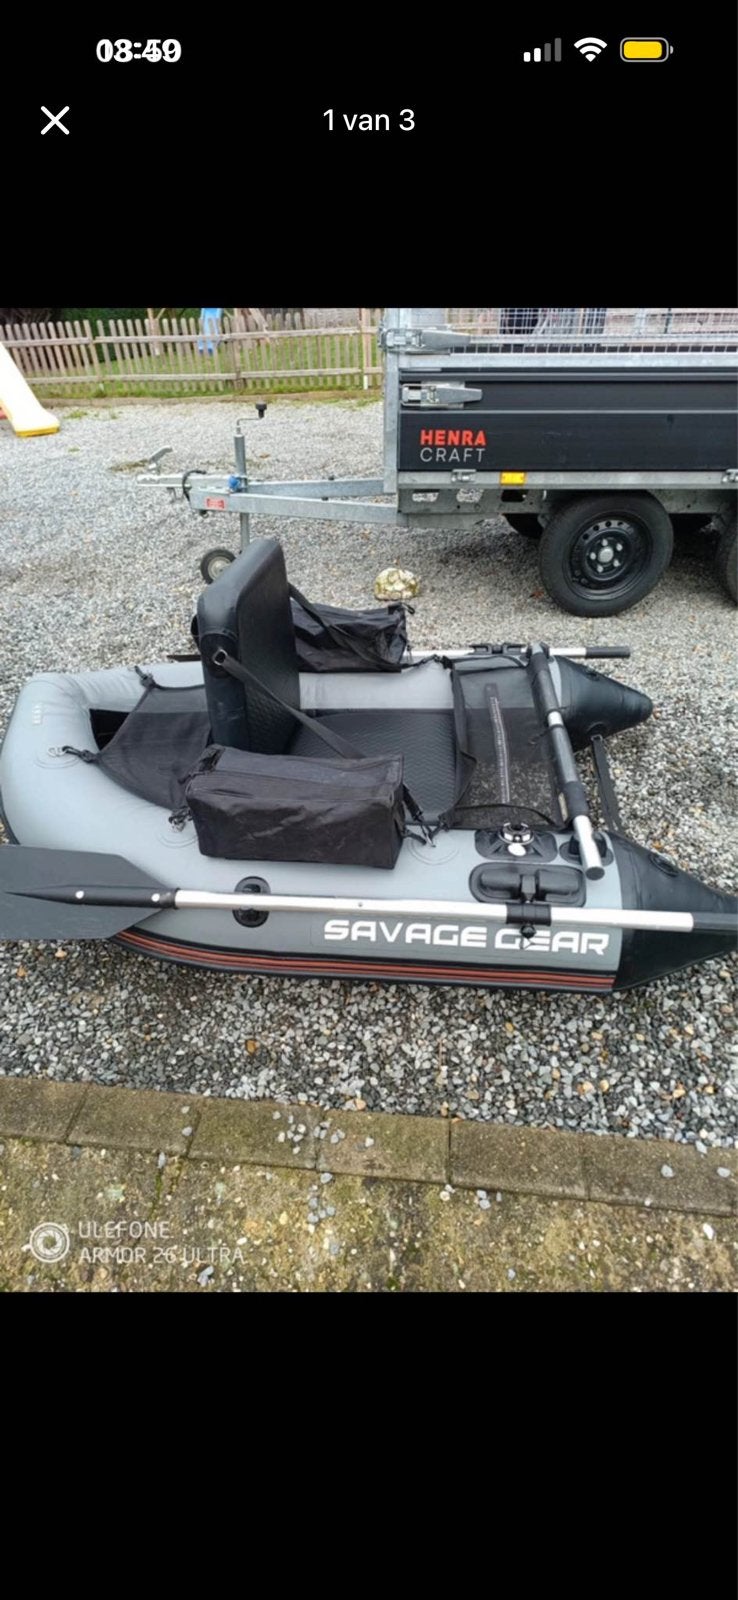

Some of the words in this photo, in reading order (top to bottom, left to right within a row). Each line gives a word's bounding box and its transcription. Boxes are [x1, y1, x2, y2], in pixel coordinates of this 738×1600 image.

[420, 429, 487, 446] HENRA
[420, 447, 486, 463] CRAFT
[324, 919, 487, 948] SAVAGE
[494, 927, 610, 956] GEAR
